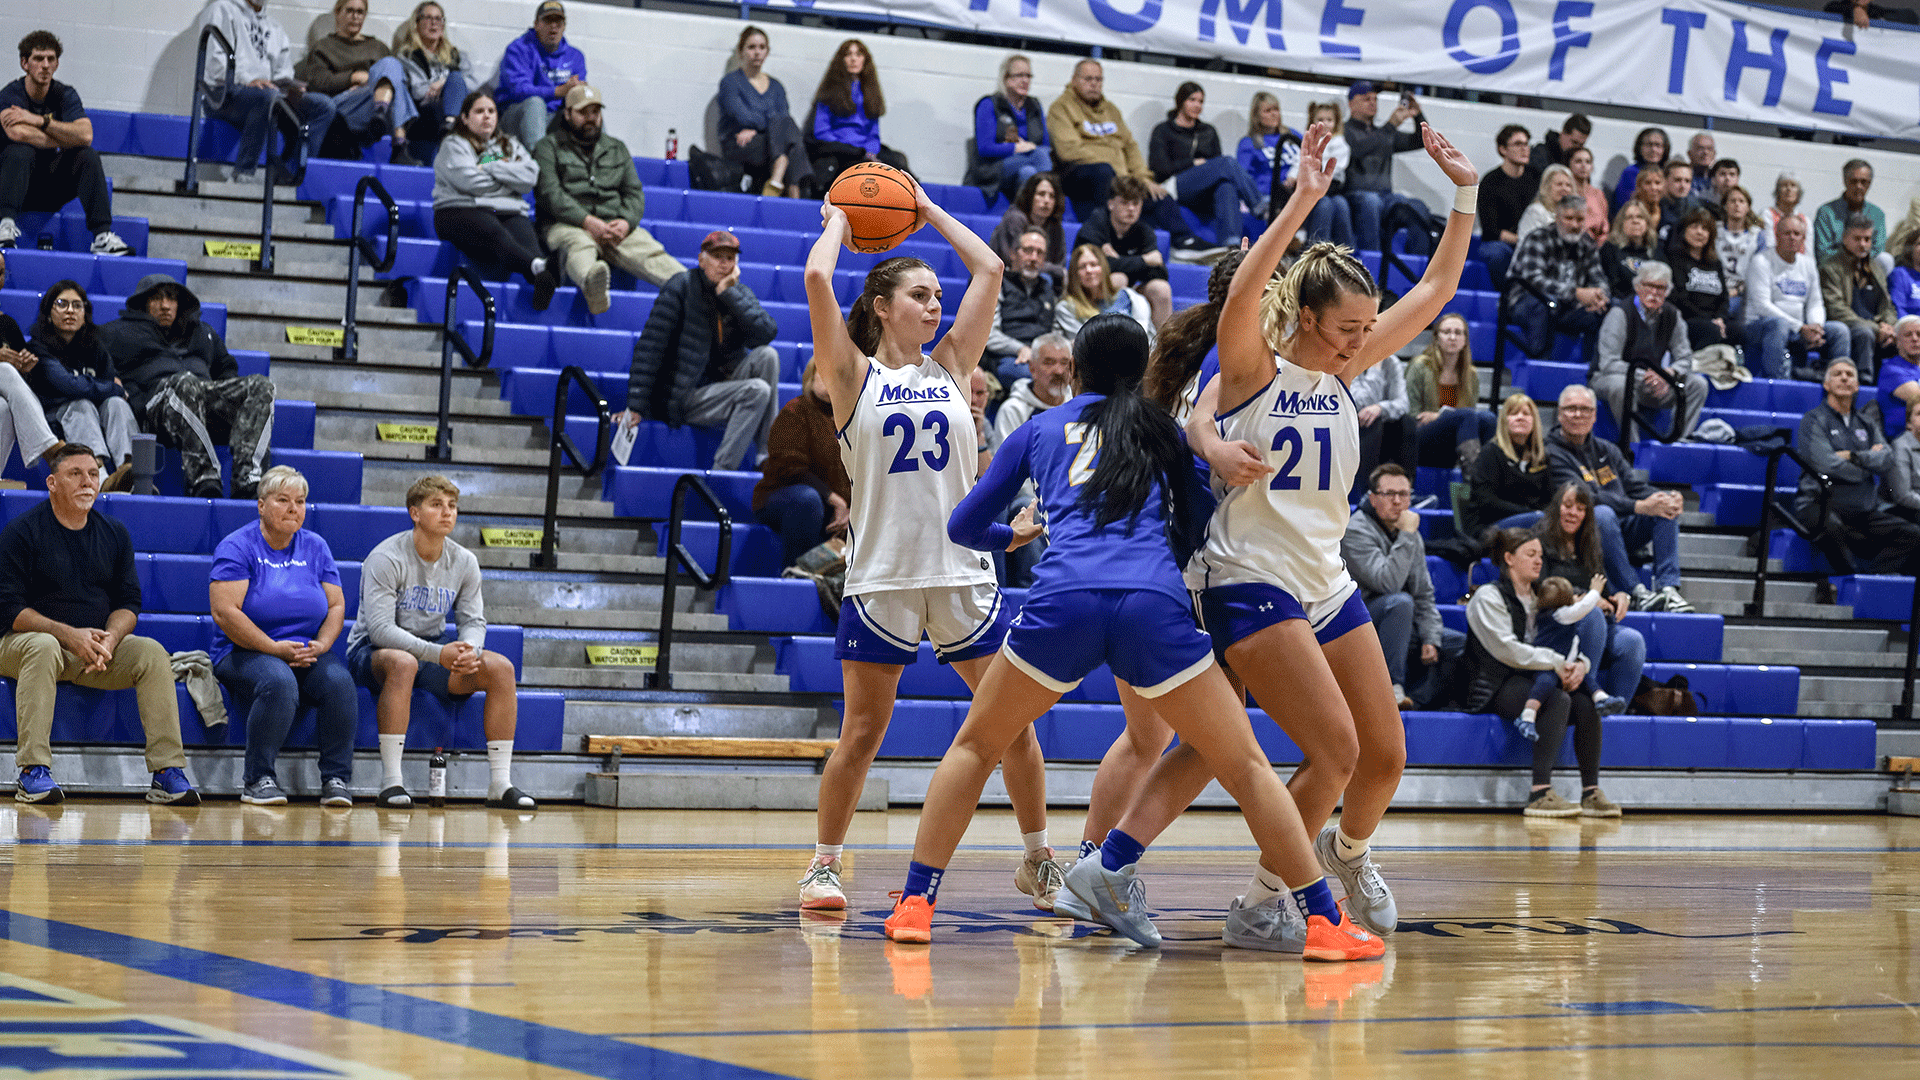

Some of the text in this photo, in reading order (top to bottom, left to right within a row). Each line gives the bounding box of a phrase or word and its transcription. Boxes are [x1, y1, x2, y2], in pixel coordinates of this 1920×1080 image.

[969, 0, 1857, 116] ME OF THE
[878, 384, 950, 403] MONKS
[1272, 390, 1339, 414] MONKS
[399, 425, 428, 433] CAUTION
[883, 410, 950, 474] 23
[1270, 426, 1331, 490] 21
[504, 530, 534, 538] CAUTION
[396, 585, 456, 613] AROLIN
[594, 655, 618, 663] WATCH
[620, 656, 637, 664] YOUR
